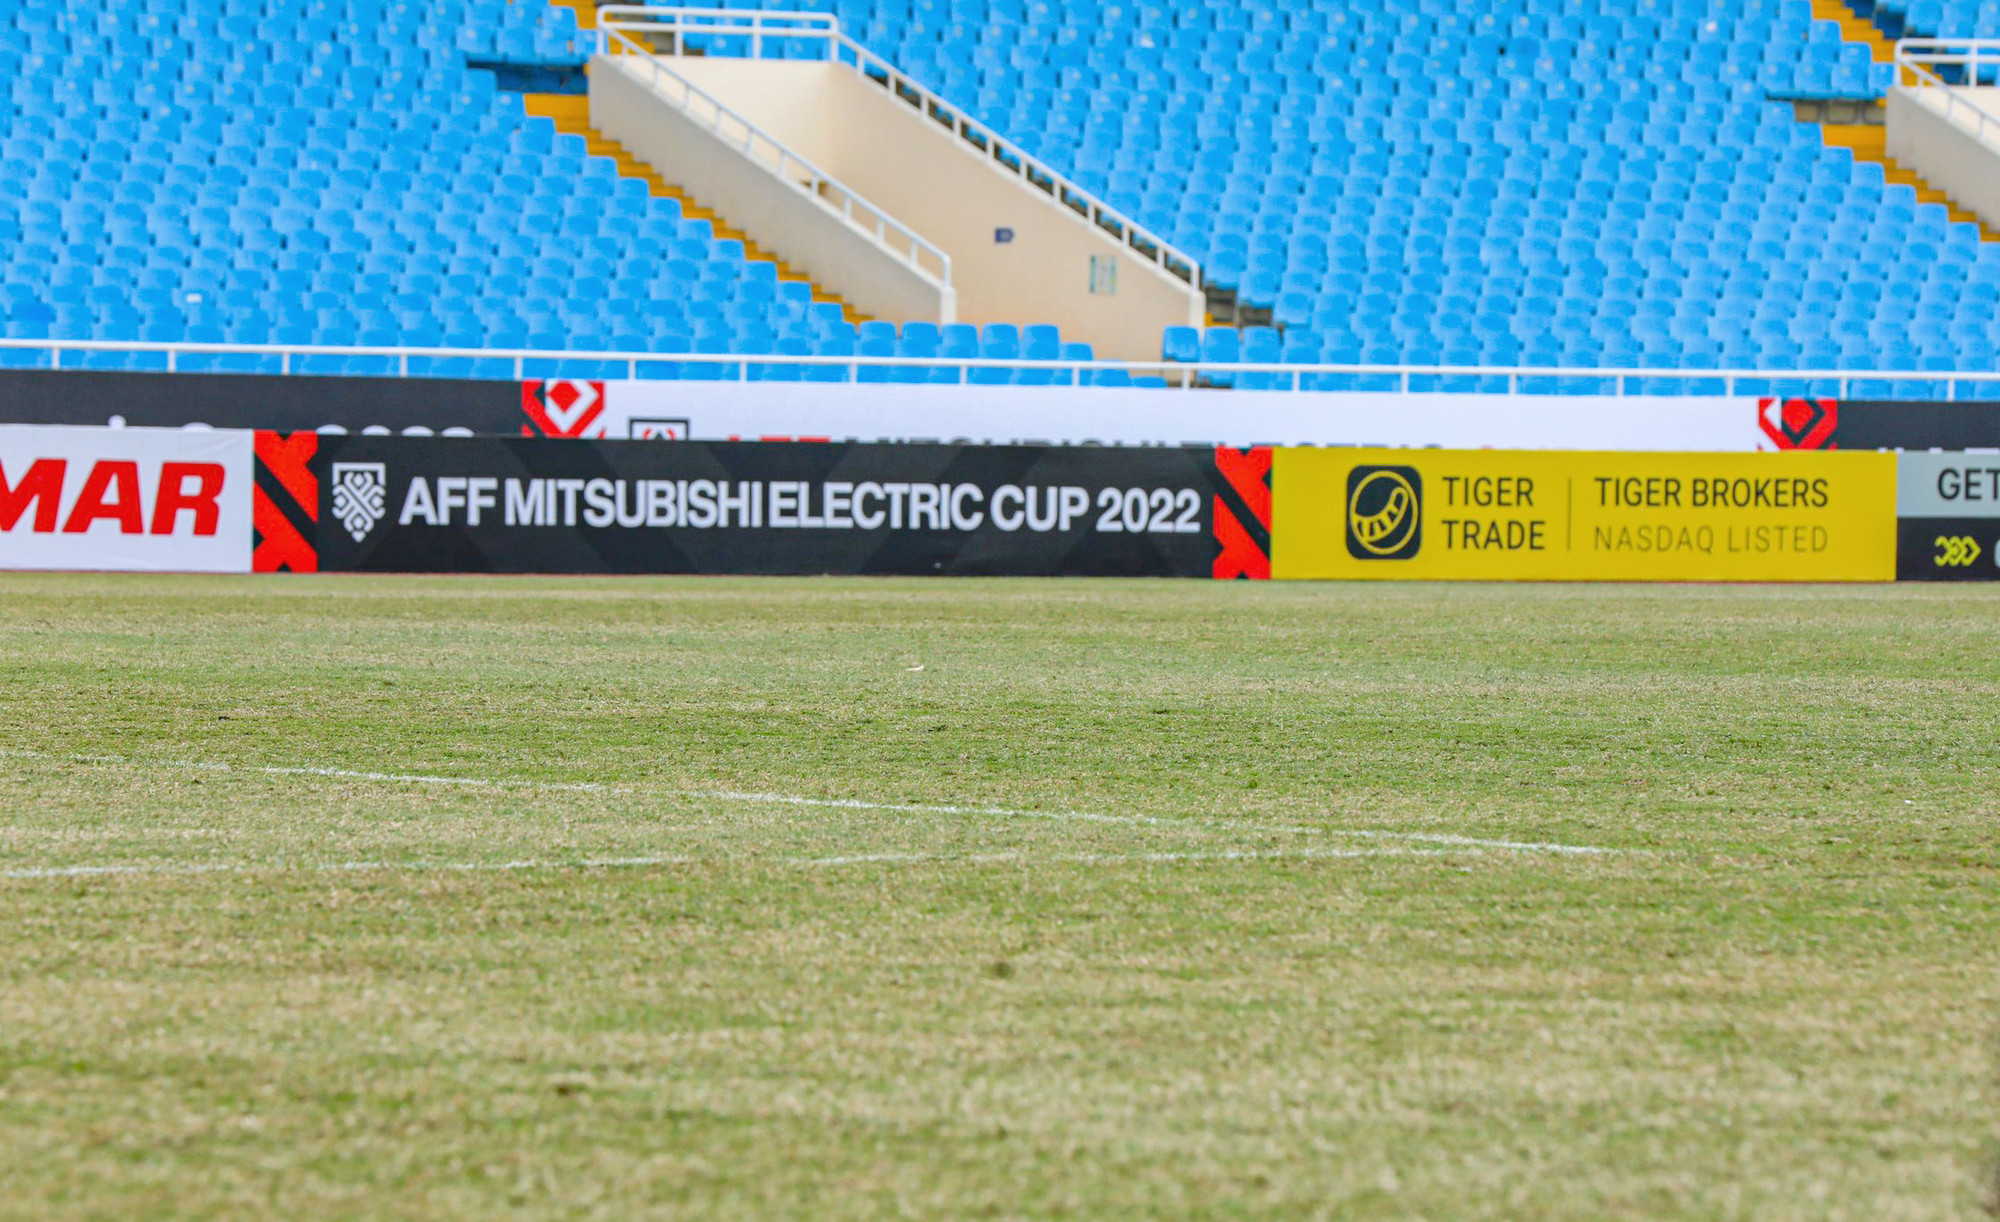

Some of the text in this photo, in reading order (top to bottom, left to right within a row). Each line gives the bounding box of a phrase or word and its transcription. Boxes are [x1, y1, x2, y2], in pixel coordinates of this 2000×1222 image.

[399, 476, 1202, 534] AFF MITSUBISHI ELECTRIC CUP 2022
[1441, 476, 1535, 508] TIGER
[1594, 476, 1830, 509] TIGER BROKERS
[1441, 520, 1546, 551] TRADE
[1594, 524, 1829, 554] NASDAQ LISTED
